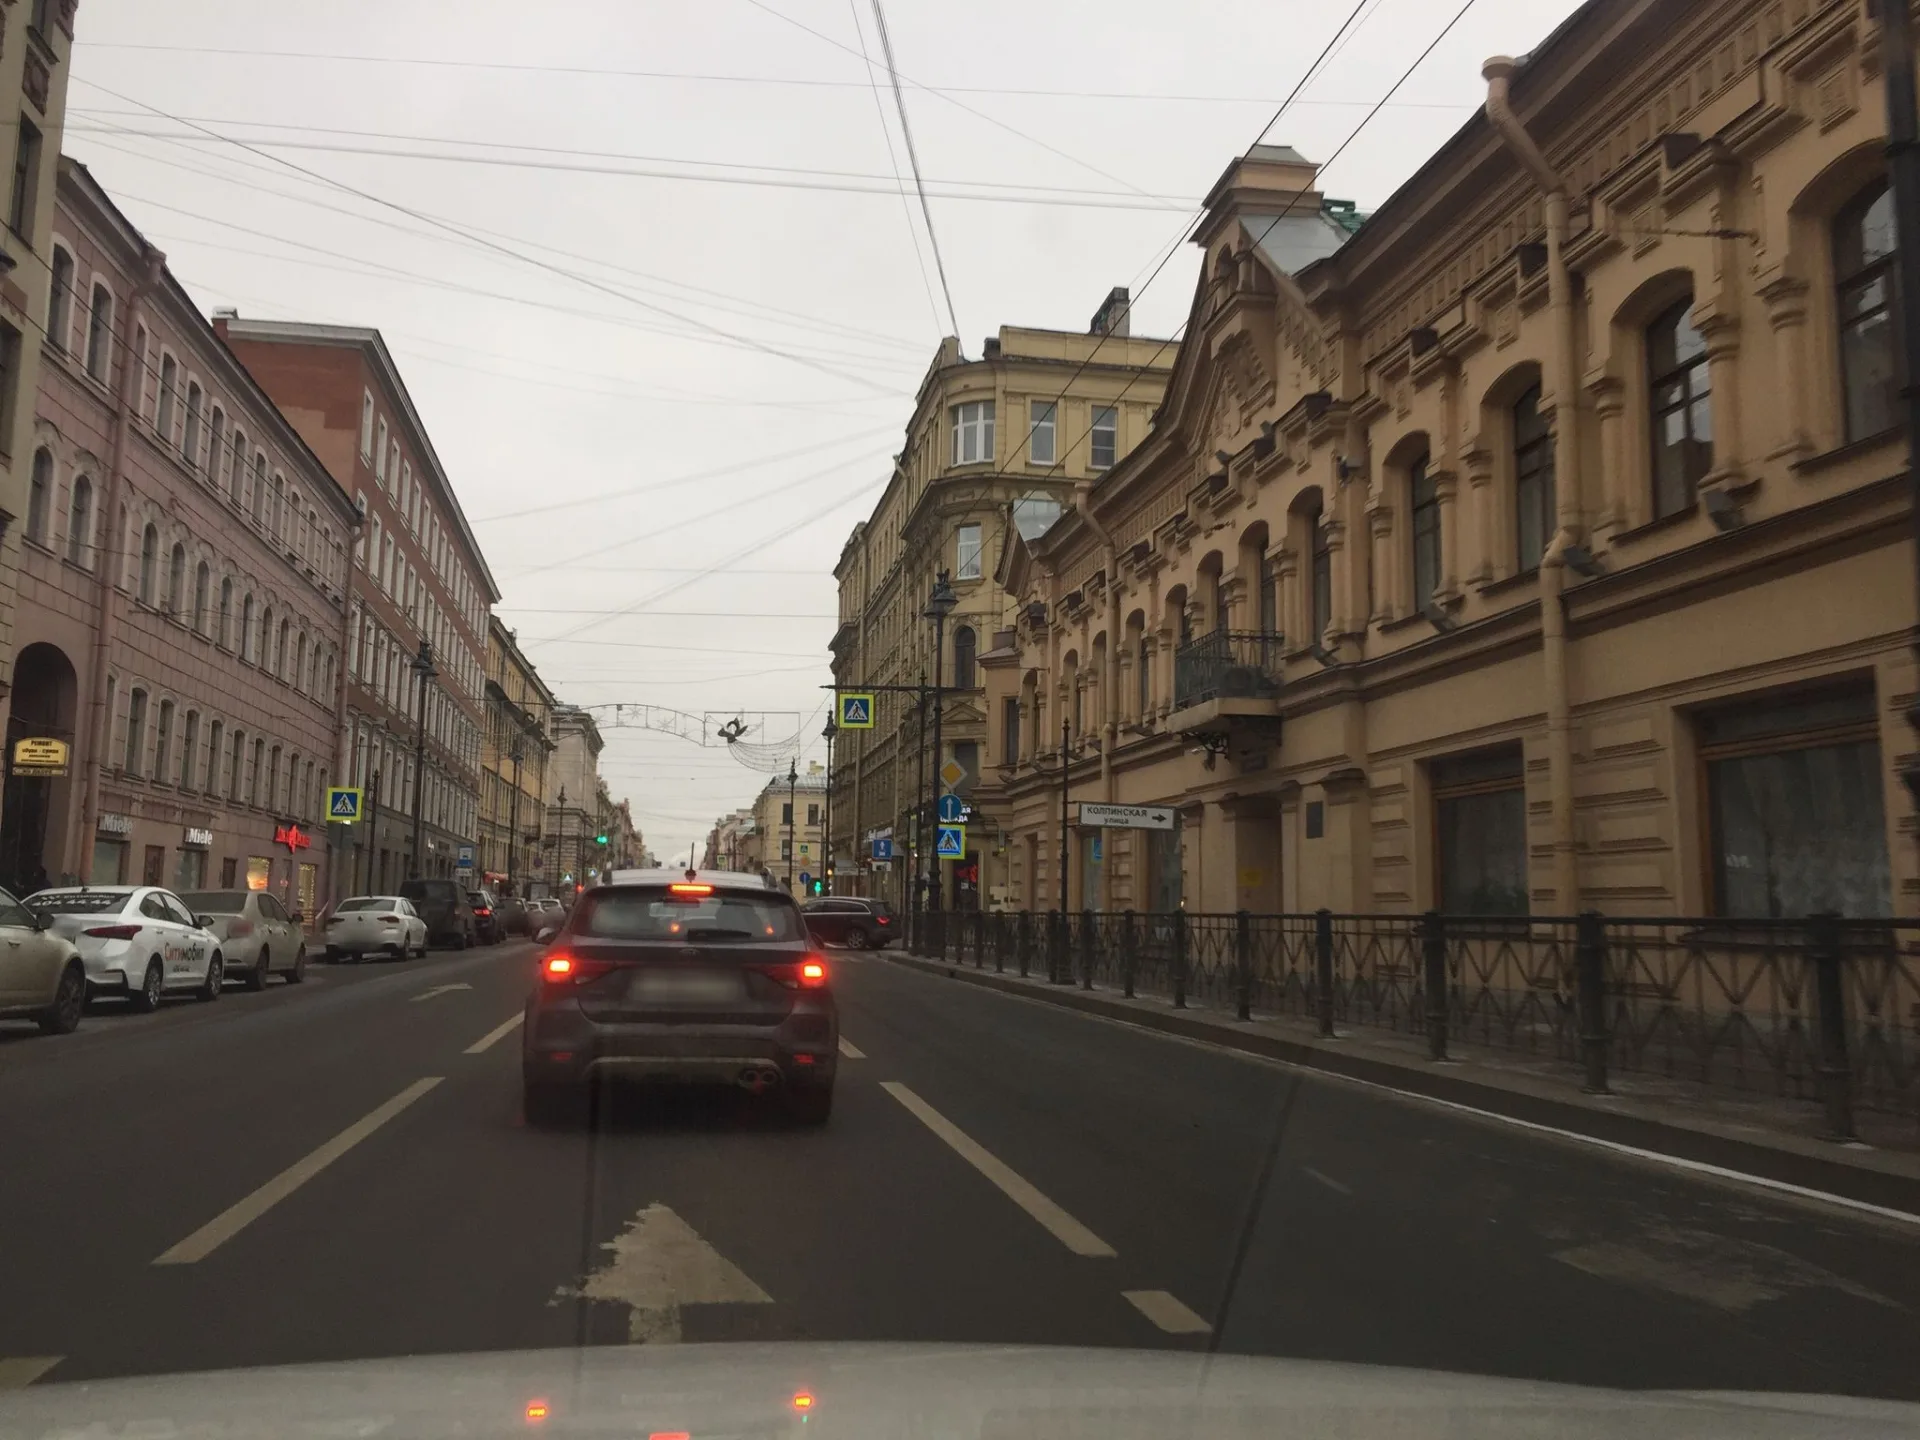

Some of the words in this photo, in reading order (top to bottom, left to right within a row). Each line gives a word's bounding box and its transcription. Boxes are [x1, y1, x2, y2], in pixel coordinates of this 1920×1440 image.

[1087, 806, 1148, 817] КОЛПИНСКАЯ
[103, 814, 133, 833] Miele
[1104, 817, 1129, 825] улица
[189, 828, 213, 844] Miele
